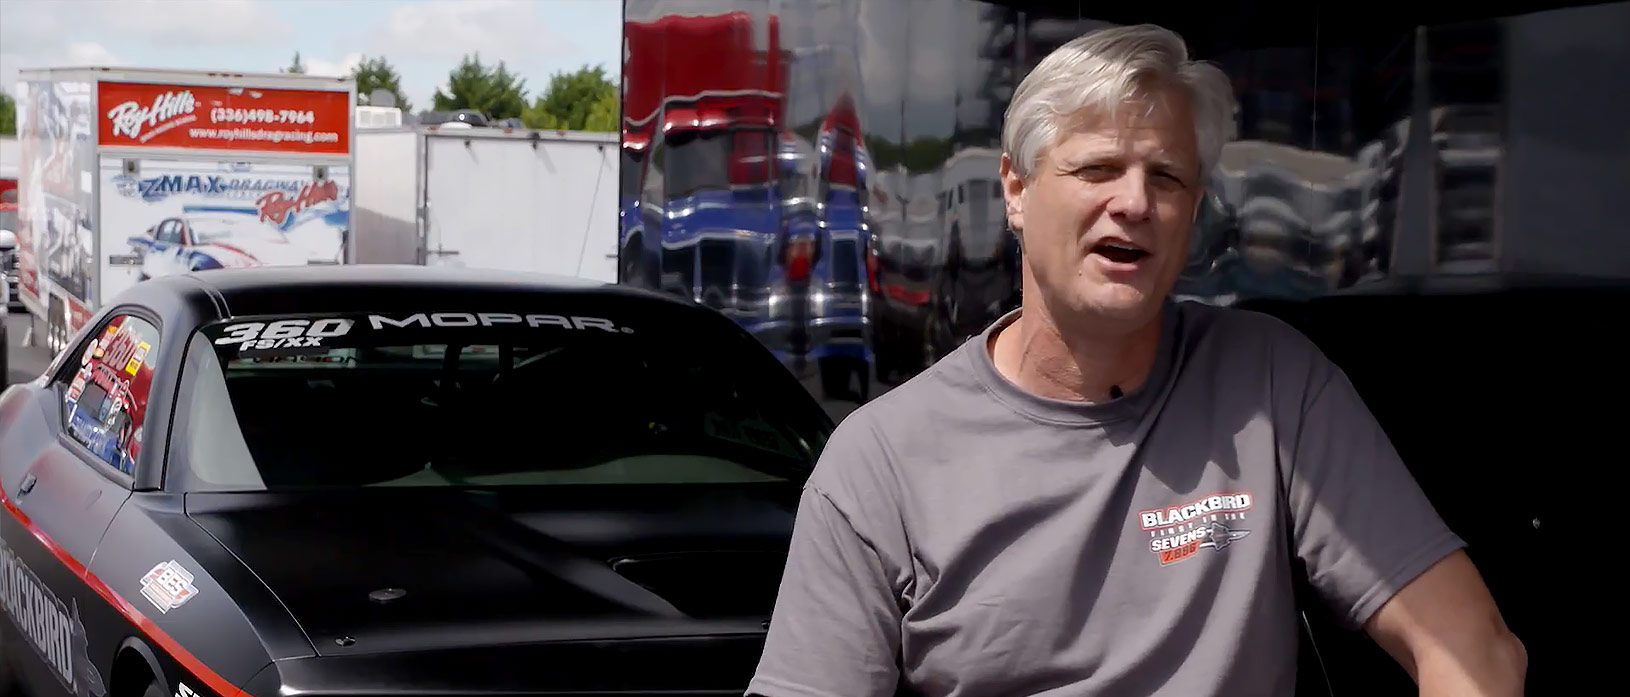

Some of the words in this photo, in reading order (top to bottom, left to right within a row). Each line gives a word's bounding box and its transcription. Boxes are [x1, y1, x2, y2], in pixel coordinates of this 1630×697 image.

[107, 101, 149, 139] Roy
[215, 318, 355, 345] 360
[239, 336, 323, 352] FS/XX
[1141, 493, 1251, 528] BLACKBIRD
[1150, 522, 1194, 538] FIRST
[1151, 525, 1207, 552] SEVENS
